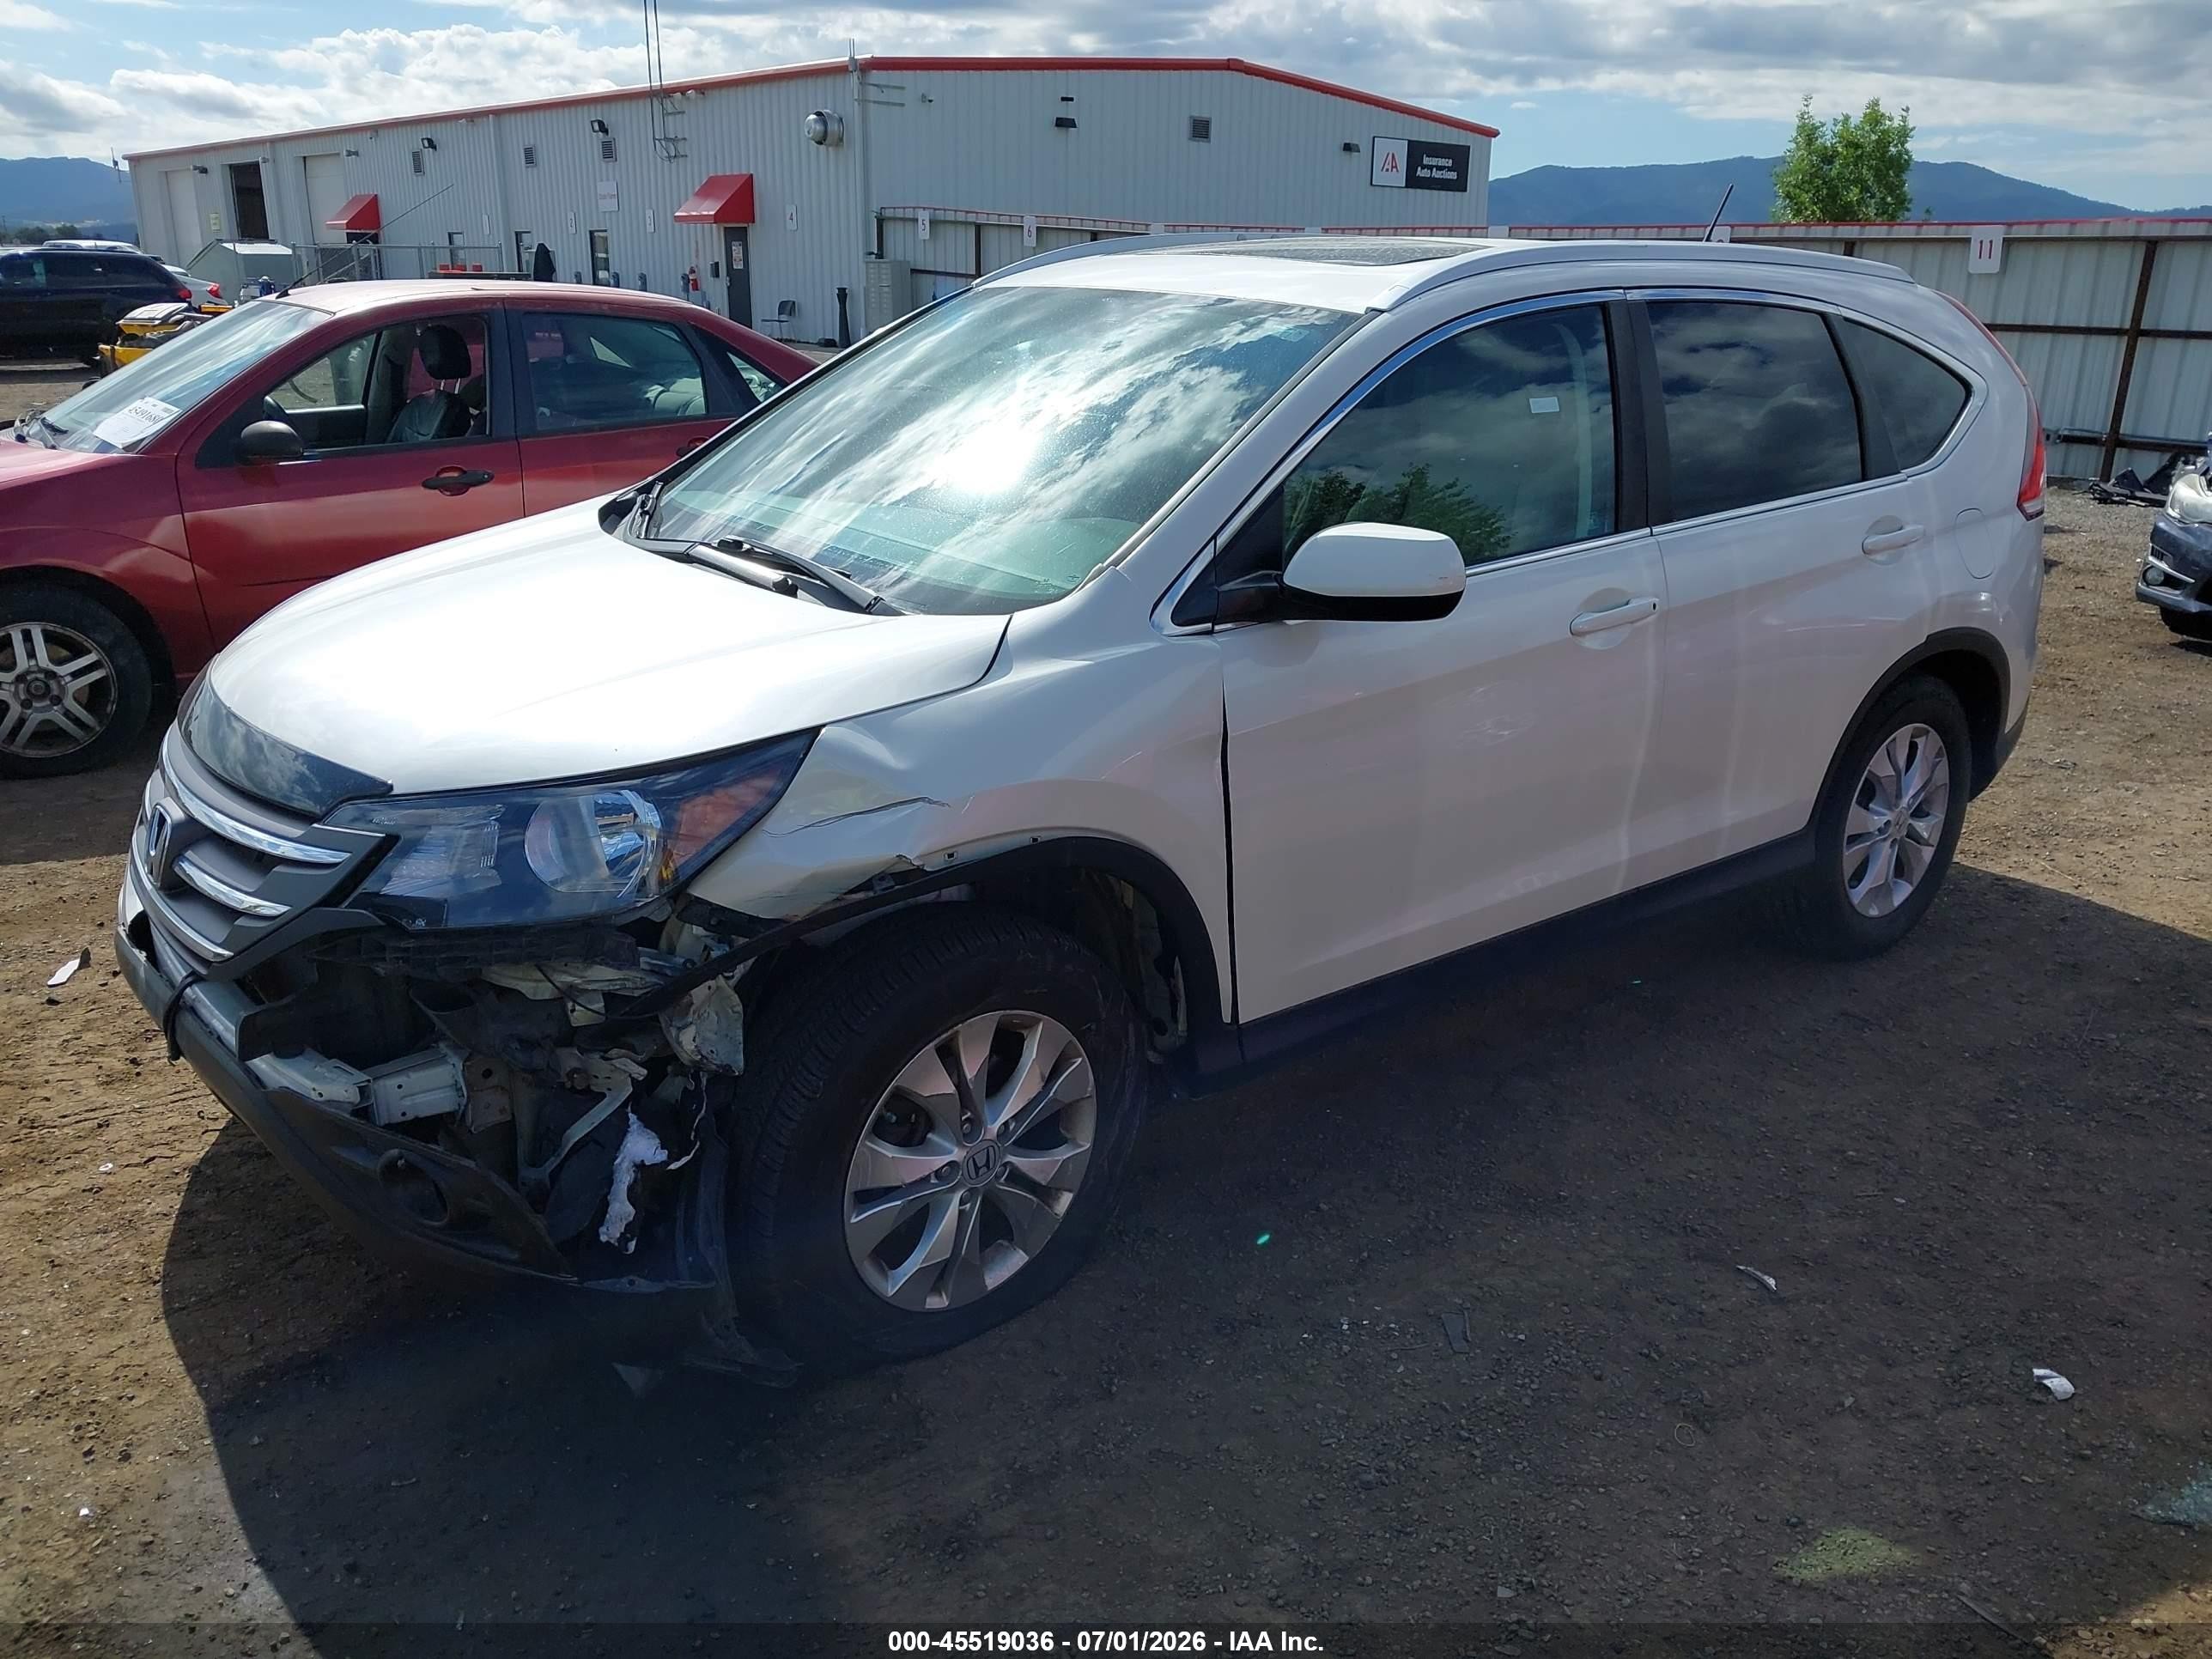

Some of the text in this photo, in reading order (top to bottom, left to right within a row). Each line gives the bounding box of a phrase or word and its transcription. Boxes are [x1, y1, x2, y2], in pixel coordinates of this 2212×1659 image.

[1423, 154, 1453, 167] Insurance
[1416, 166, 1458, 180] Auto Auctions
[789, 212, 793, 223] 4
[921, 218, 926, 232] 5
[1027, 224, 1032, 238] 6
[1978, 239, 1993, 259] 11
